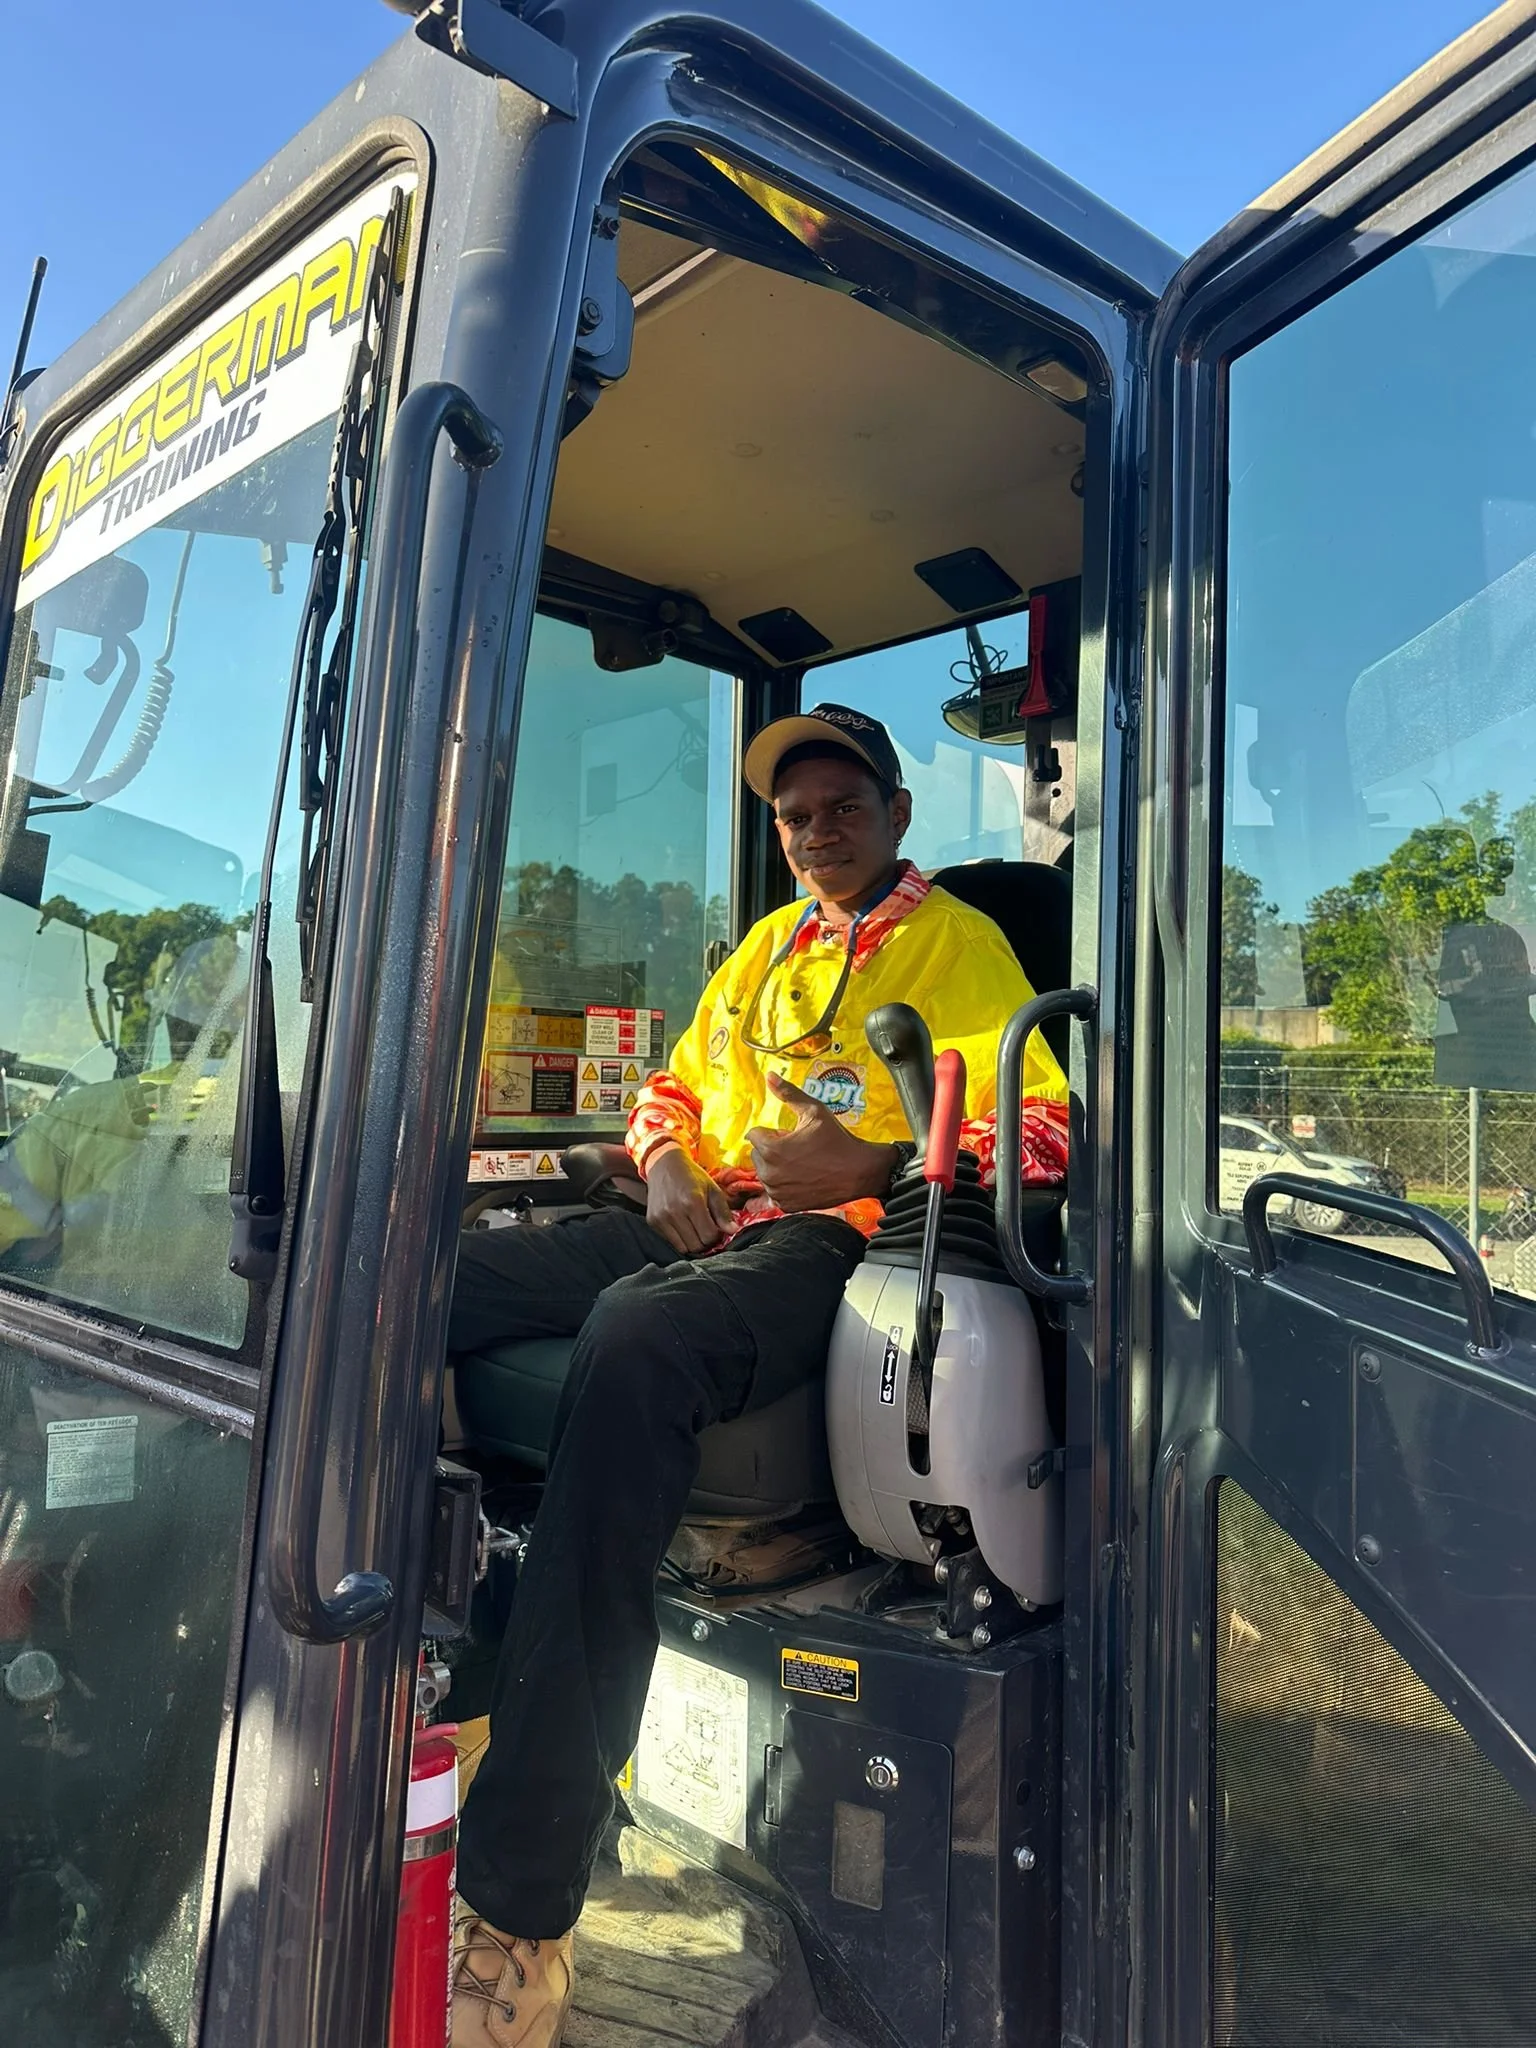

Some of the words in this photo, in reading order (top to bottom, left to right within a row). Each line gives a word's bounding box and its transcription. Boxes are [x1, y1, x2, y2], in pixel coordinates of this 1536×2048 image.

[99, 388, 266, 535] TRAINING
[549, 1056, 575, 1067] DANGER
[806, 1653, 847, 1667] CAUTION
